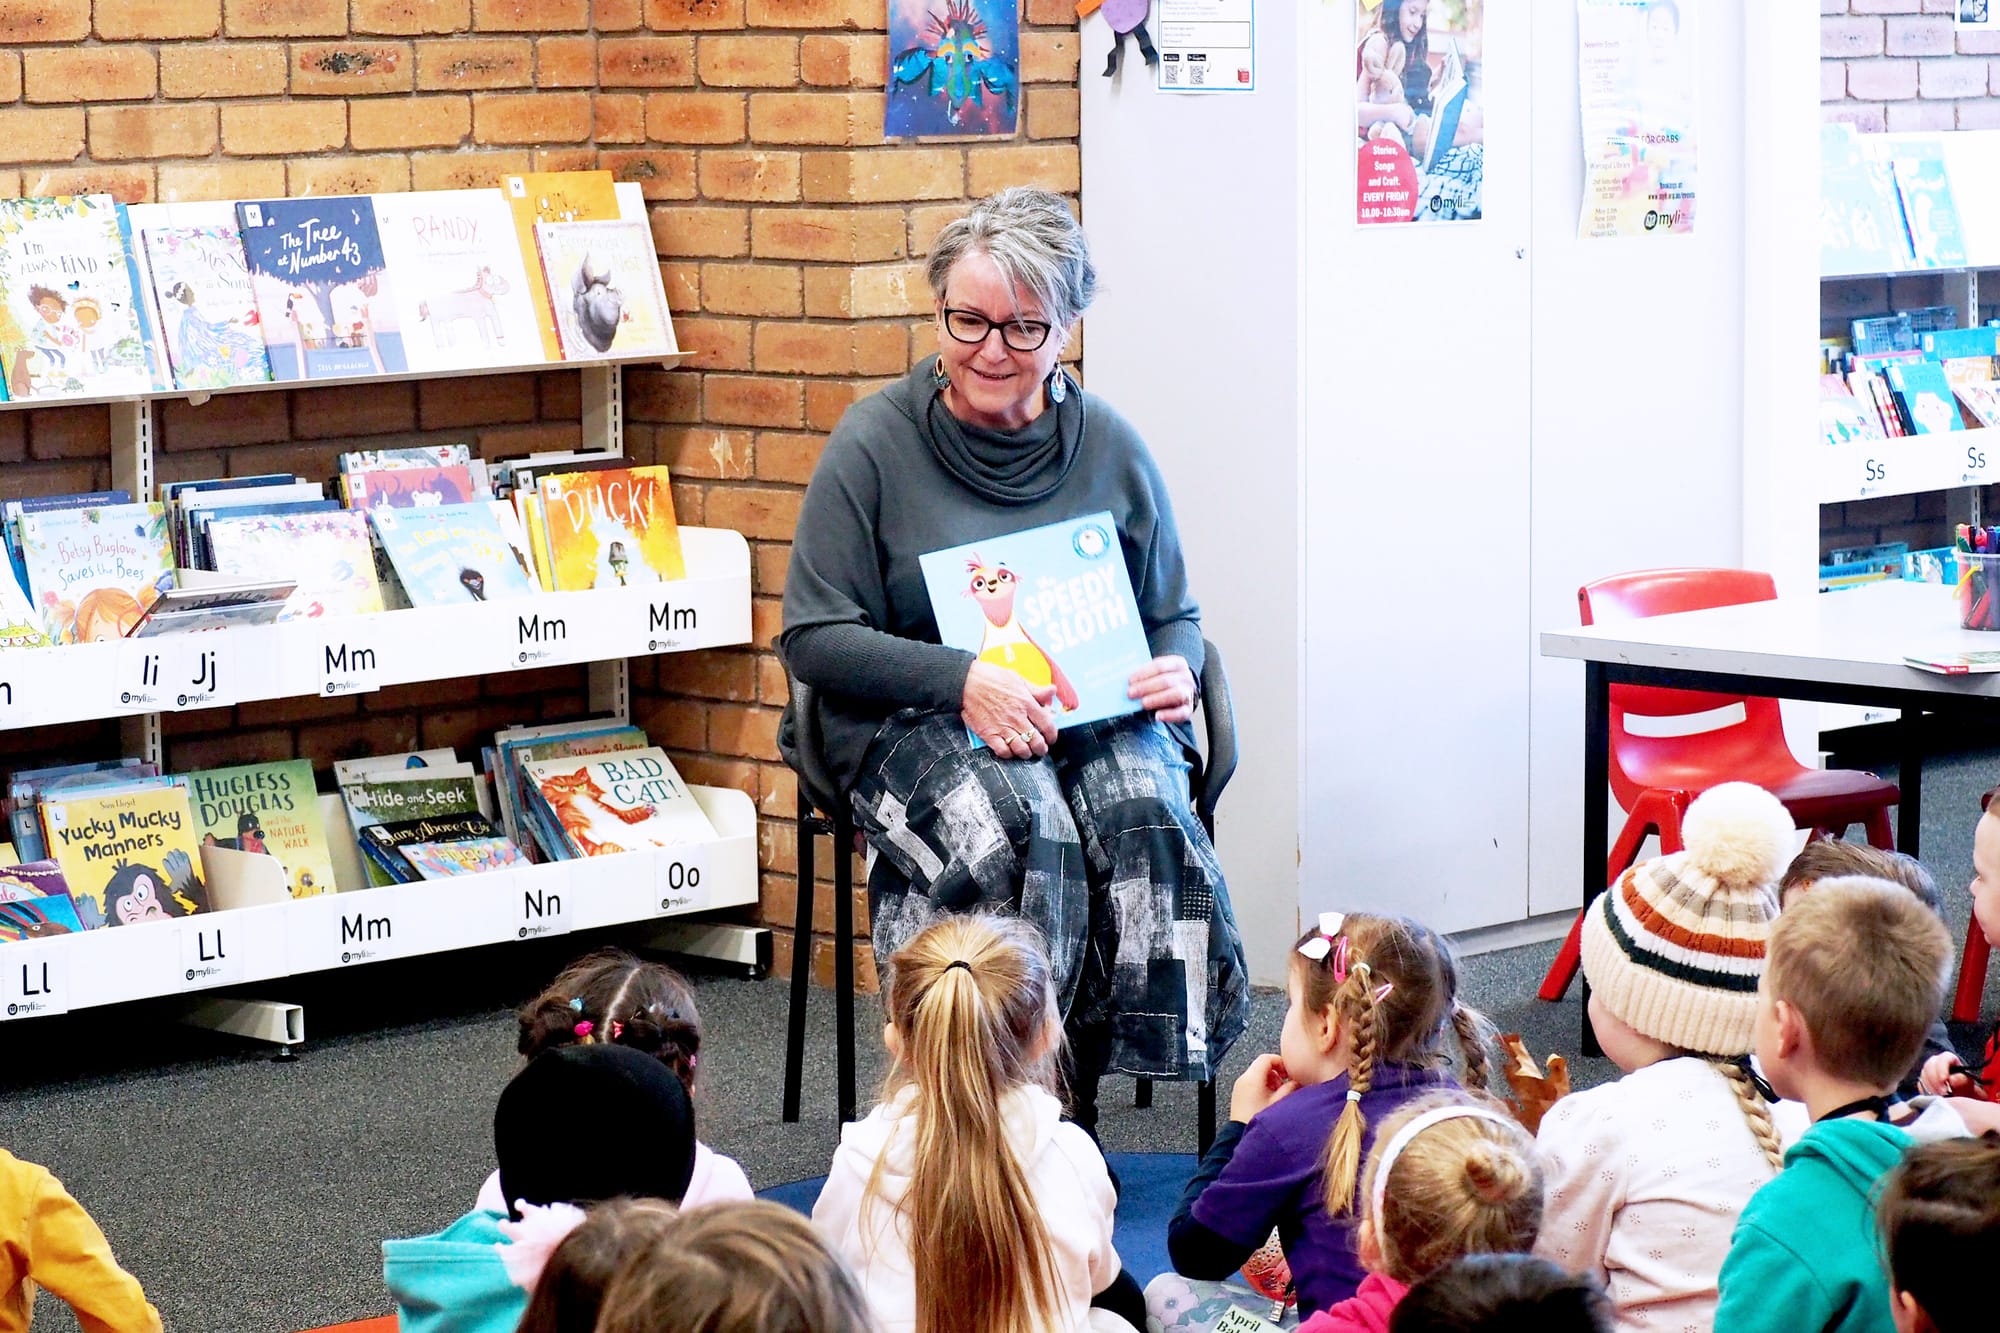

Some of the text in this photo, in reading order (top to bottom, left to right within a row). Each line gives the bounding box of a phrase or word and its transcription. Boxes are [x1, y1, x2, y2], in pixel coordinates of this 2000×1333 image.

[1372, 145, 1398, 156] Stories,
[1656, 134, 1680, 144] GRABS
[1374, 161, 1396, 173] Songs
[1368, 176, 1400, 187] and Craft.
[1363, 191, 1409, 202] EVERY FRIDAY
[1443, 195, 1463, 210] myli
[1659, 209, 1681, 228] myli
[280, 218, 342, 252] The Tree
[23, 241, 45, 256] I'm
[277, 236, 361, 275] at Number 43
[60, 253, 98, 275] KIND
[1967, 446, 1986, 469] Ss
[523, 477, 529, 485] M
[1866, 459, 1885, 481] Ss
[354, 482, 361, 490] M
[562, 479, 654, 534] DUCK!
[57, 534, 137, 564] Betsy Buglove
[58, 557, 145, 591] Saves the Bees
[1023, 563, 1116, 628] SPEEDY
[518, 614, 566, 644] Mm
[650, 602, 697, 632] Mm
[1046, 594, 1129, 654] SLOTH
[143, 655, 159, 686] Ii
[325, 643, 375, 674] Mm
[192, 651, 216, 692] Jj
[131, 694, 147, 703] myli
[188, 693, 205, 703] myli
[598, 757, 663, 782] BAD
[364, 787, 467, 807] Hide and Seek
[613, 779, 682, 805] CAT!
[200, 793, 294, 827] DOUGLAS
[59, 810, 182, 846] Yucky Mucky
[269, 825, 307, 839] NATURE
[415, 821, 461, 842] Above
[461, 820, 490, 834] Us
[83, 833, 164, 861] Manners
[283, 839, 310, 849] WALK
[668, 861, 700, 890] Oo
[525, 889, 561, 919] Nn
[341, 913, 391, 944] Mm
[198, 929, 226, 962] Ll
[22, 962, 51, 996] Ll
[196, 967, 211, 977] myli
[18, 1002, 36, 1013] myli
[1225, 1309, 1261, 1332] April
